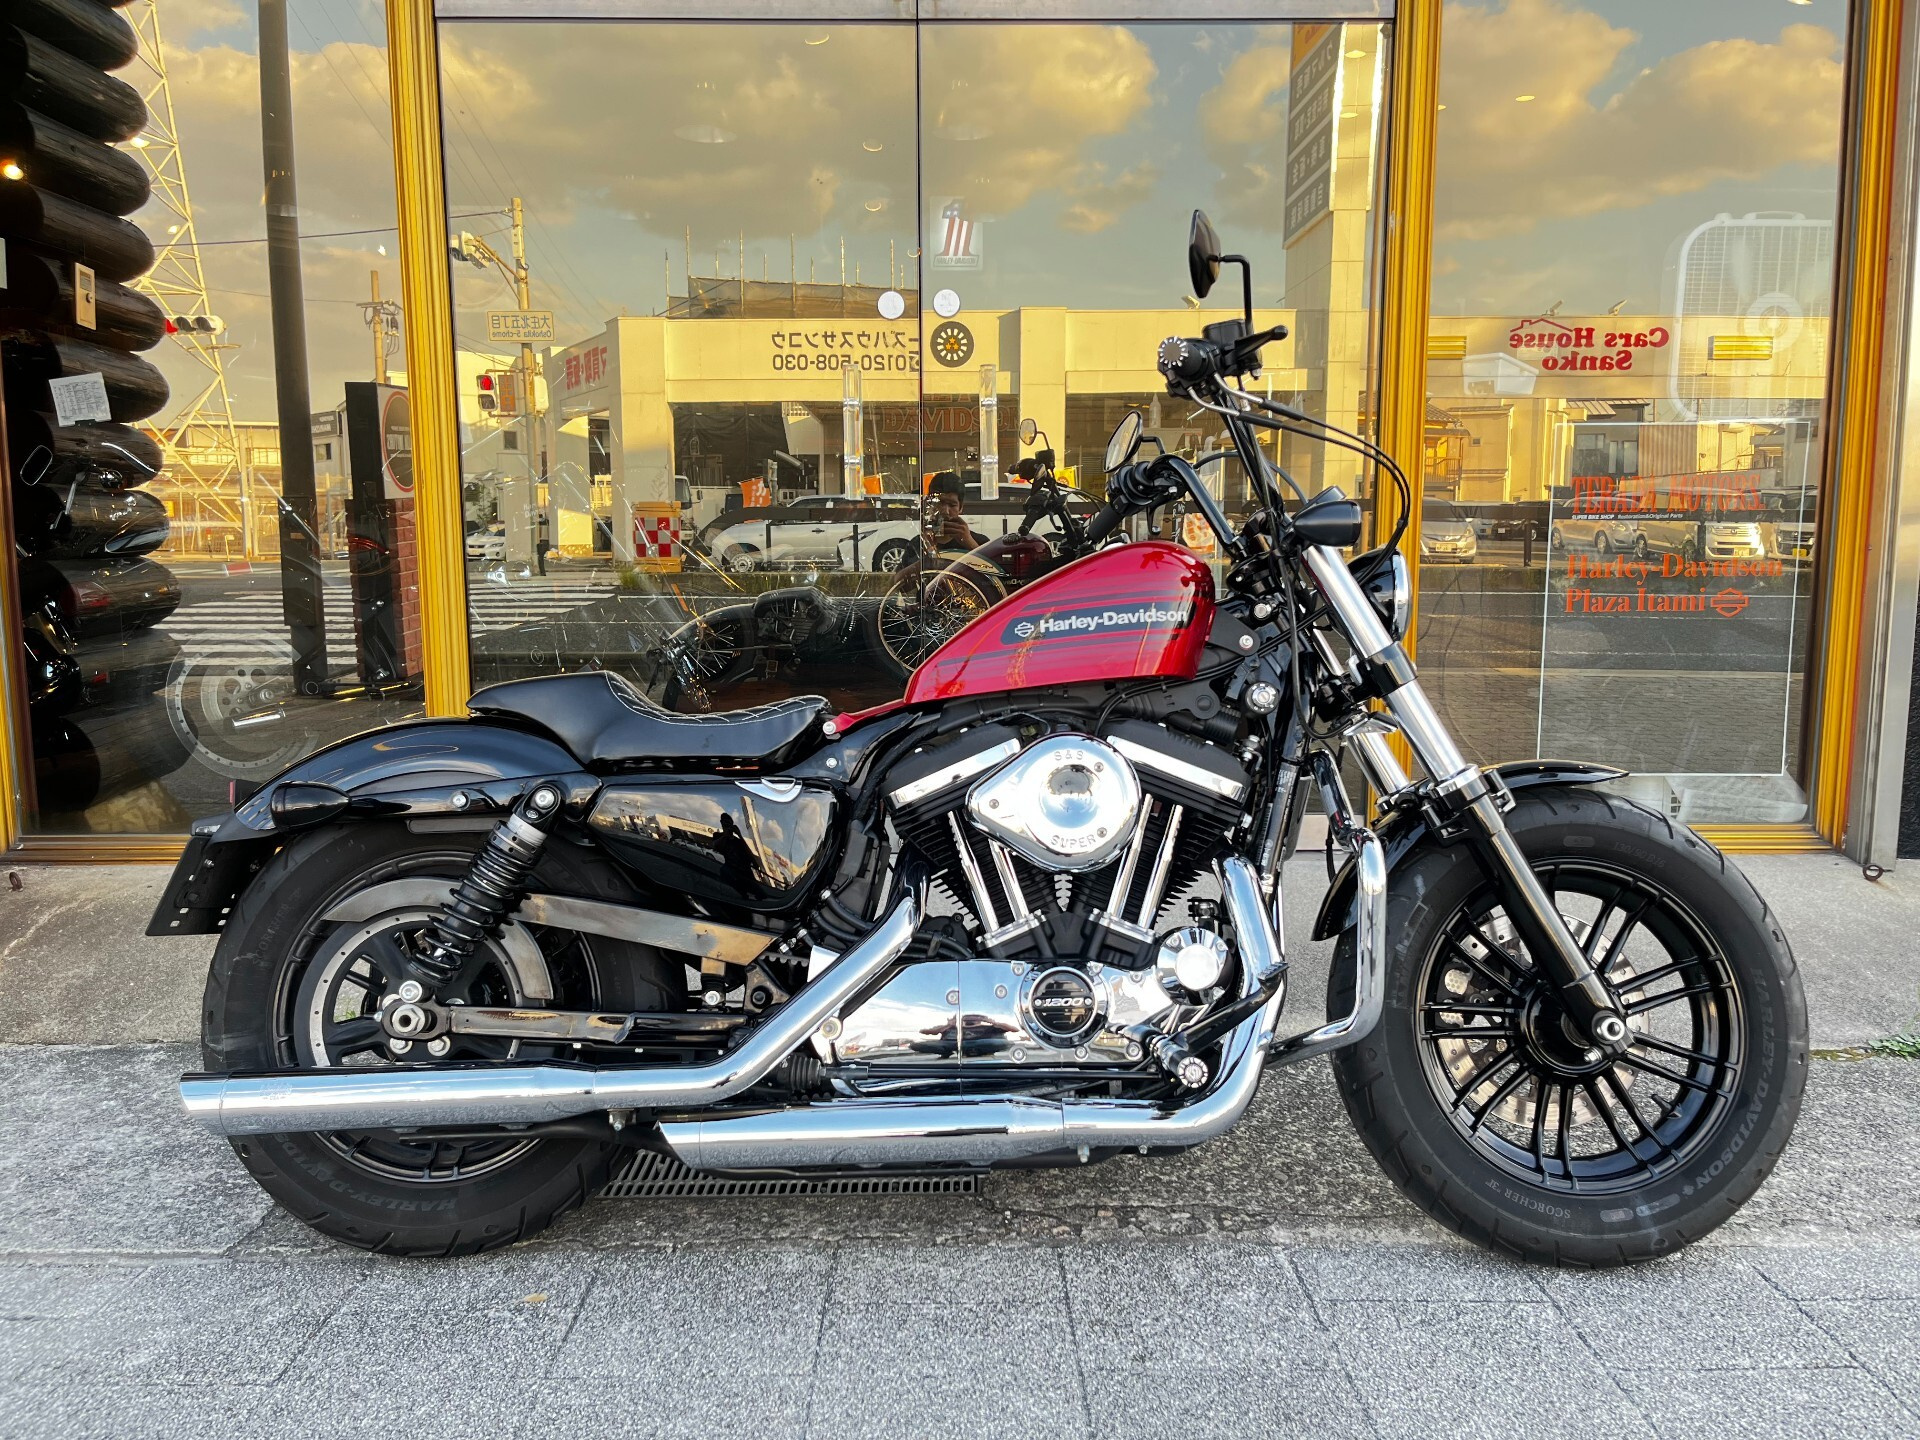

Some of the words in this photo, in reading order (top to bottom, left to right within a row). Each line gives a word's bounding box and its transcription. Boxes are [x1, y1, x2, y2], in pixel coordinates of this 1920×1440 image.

[1571, 474, 1658, 514] TERADA
[1567, 553, 1784, 585] Harley-Davidson
[1564, 588, 1631, 613] Plaza
[1635, 587, 1706, 613] Itami
[1039, 607, 1188, 634] Harley-Davidson
[1053, 750, 1084, 761] S&S
[1050, 834, 1097, 849] SUPER
[1043, 997, 1085, 1007] 1200
[1695, 967, 1775, 1190] HARLEY-DAVIDSON
[1503, 1187, 1571, 1219] SCORCHER
